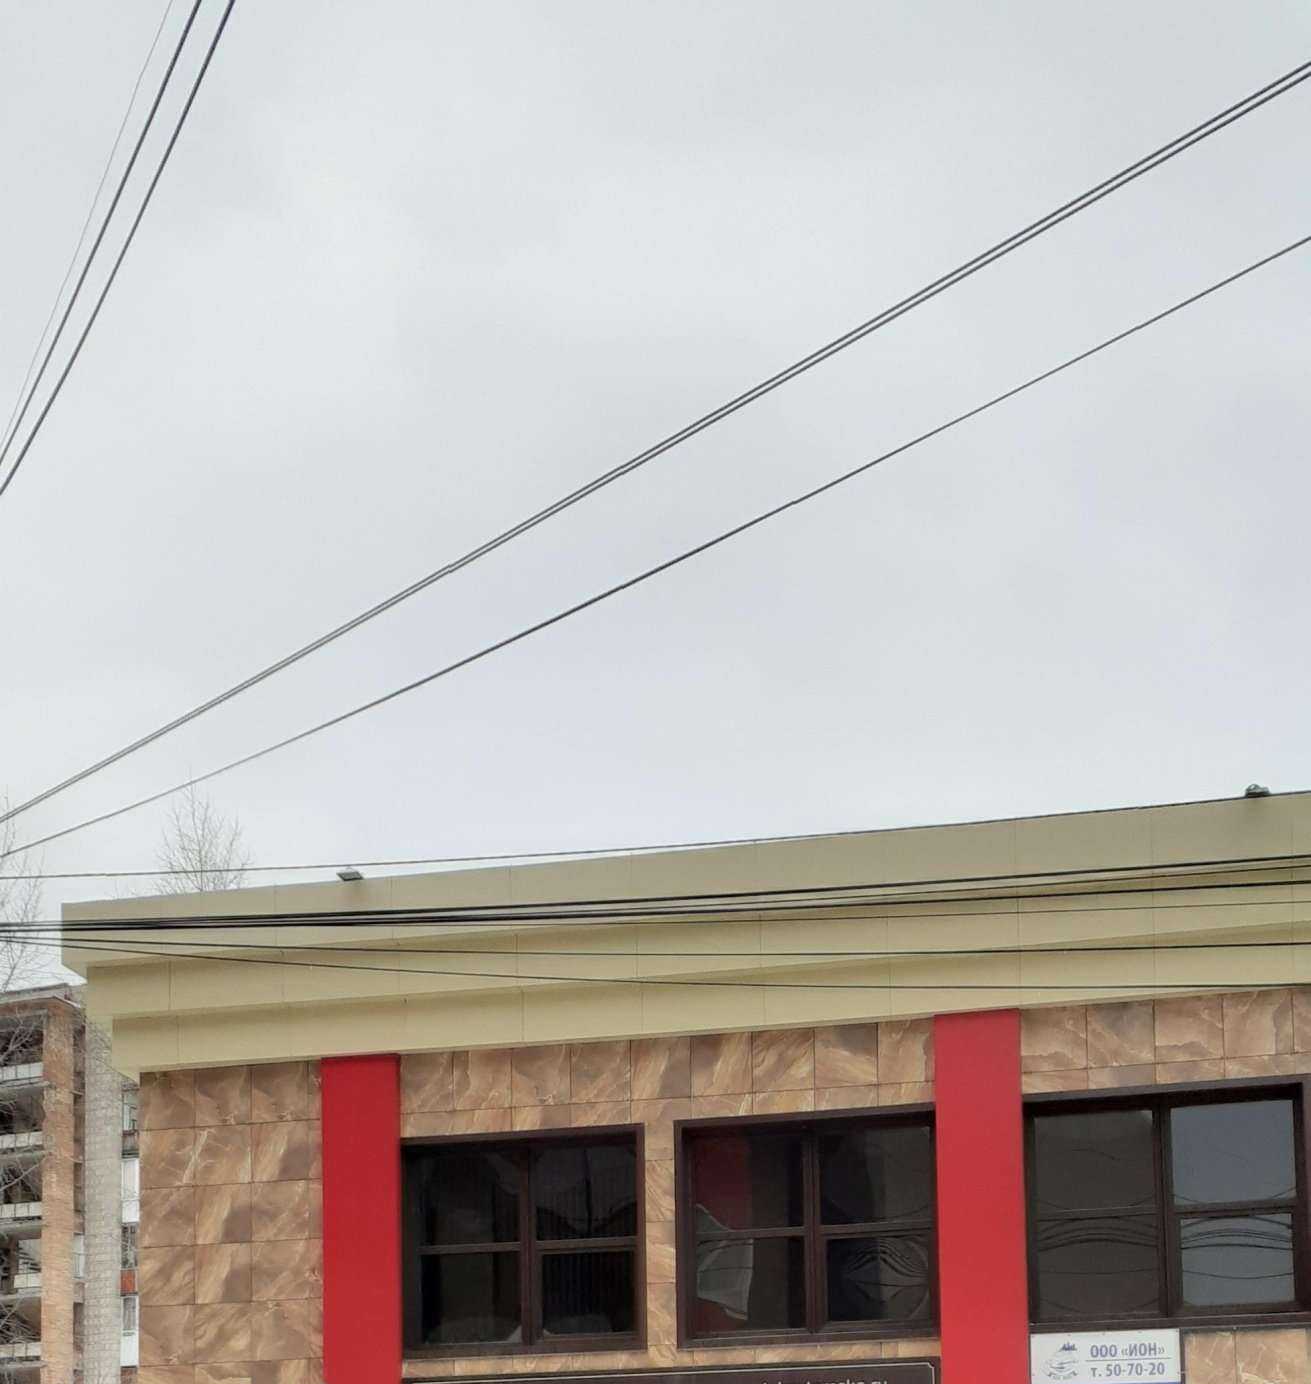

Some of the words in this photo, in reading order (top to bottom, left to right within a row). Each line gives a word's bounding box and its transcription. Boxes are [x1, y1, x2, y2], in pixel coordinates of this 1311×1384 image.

[1090, 1344, 1118, 1358] ООО
[1121, 1342, 1165, 1357] «ИОН»
[1106, 1362, 1166, 1377] 50-70-20
